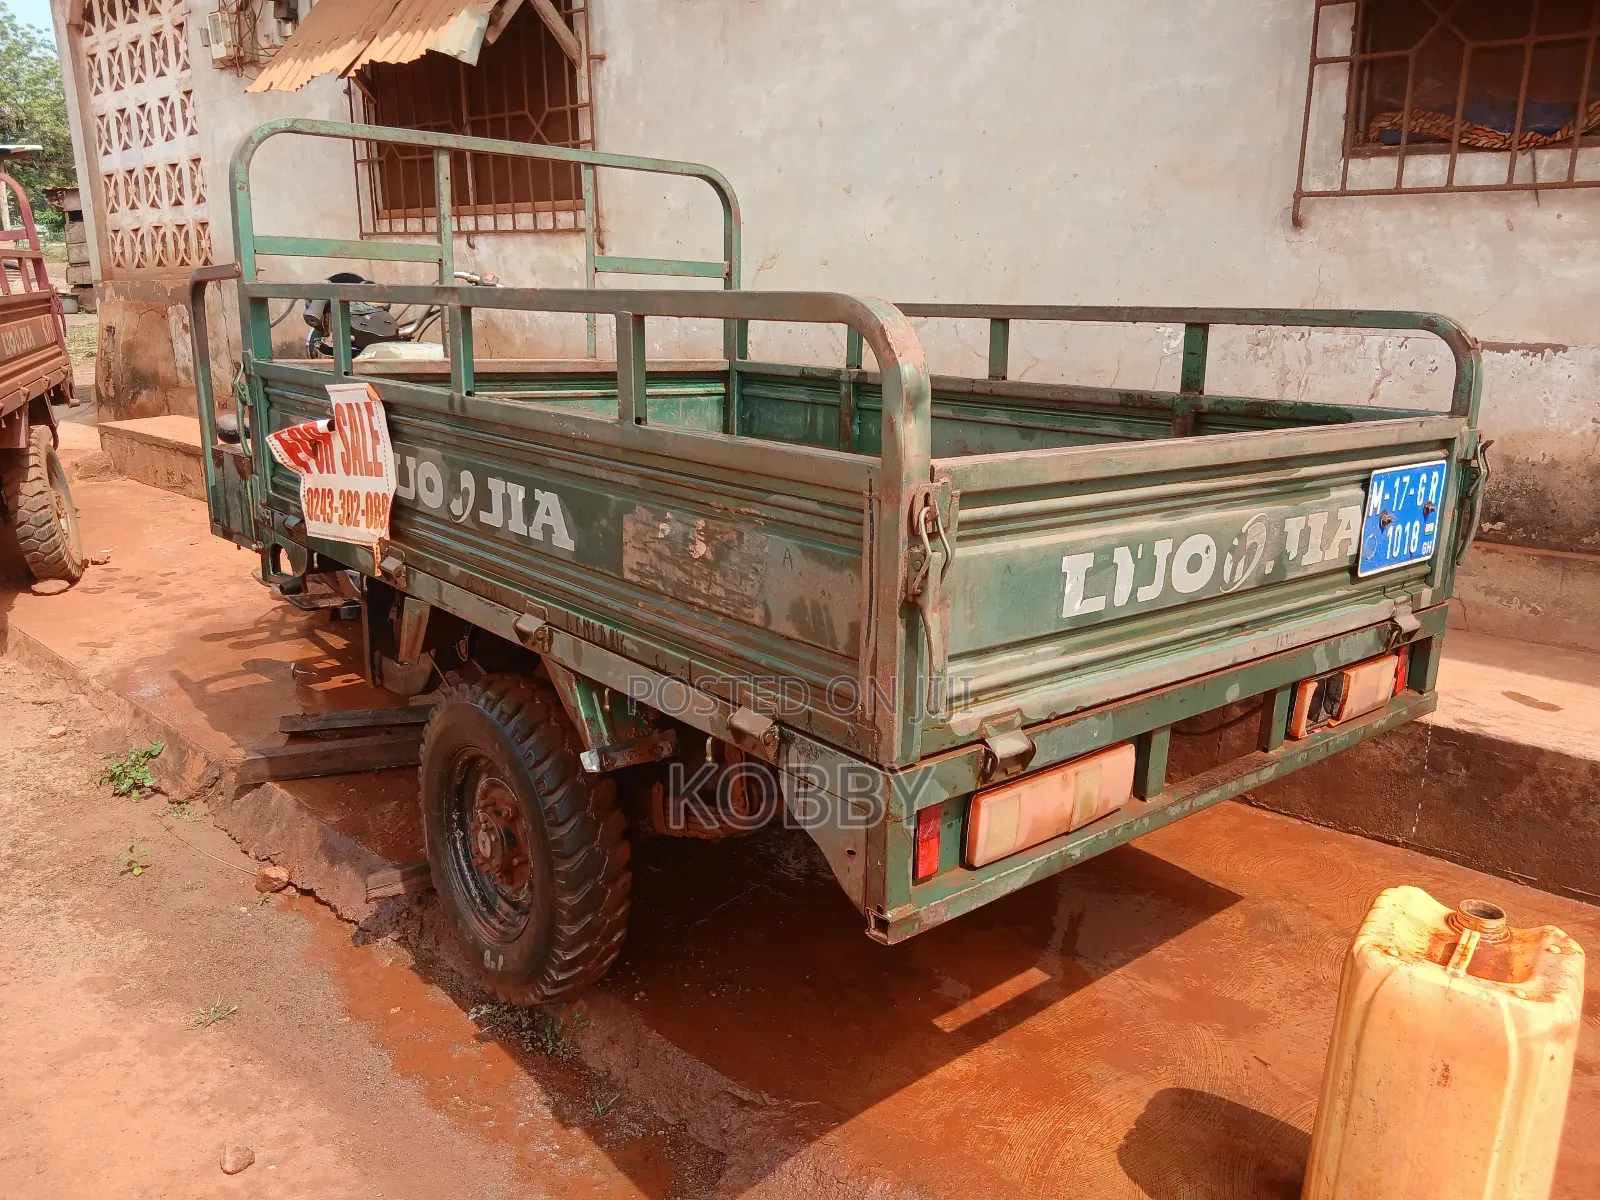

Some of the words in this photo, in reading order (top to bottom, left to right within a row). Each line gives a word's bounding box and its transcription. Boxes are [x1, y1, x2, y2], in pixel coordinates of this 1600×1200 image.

[273, 421, 337, 475] FOR
[334, 401, 384, 478] SALE
[1386, 520, 1420, 560] 1018
[1421, 540, 1433, 555] GH
